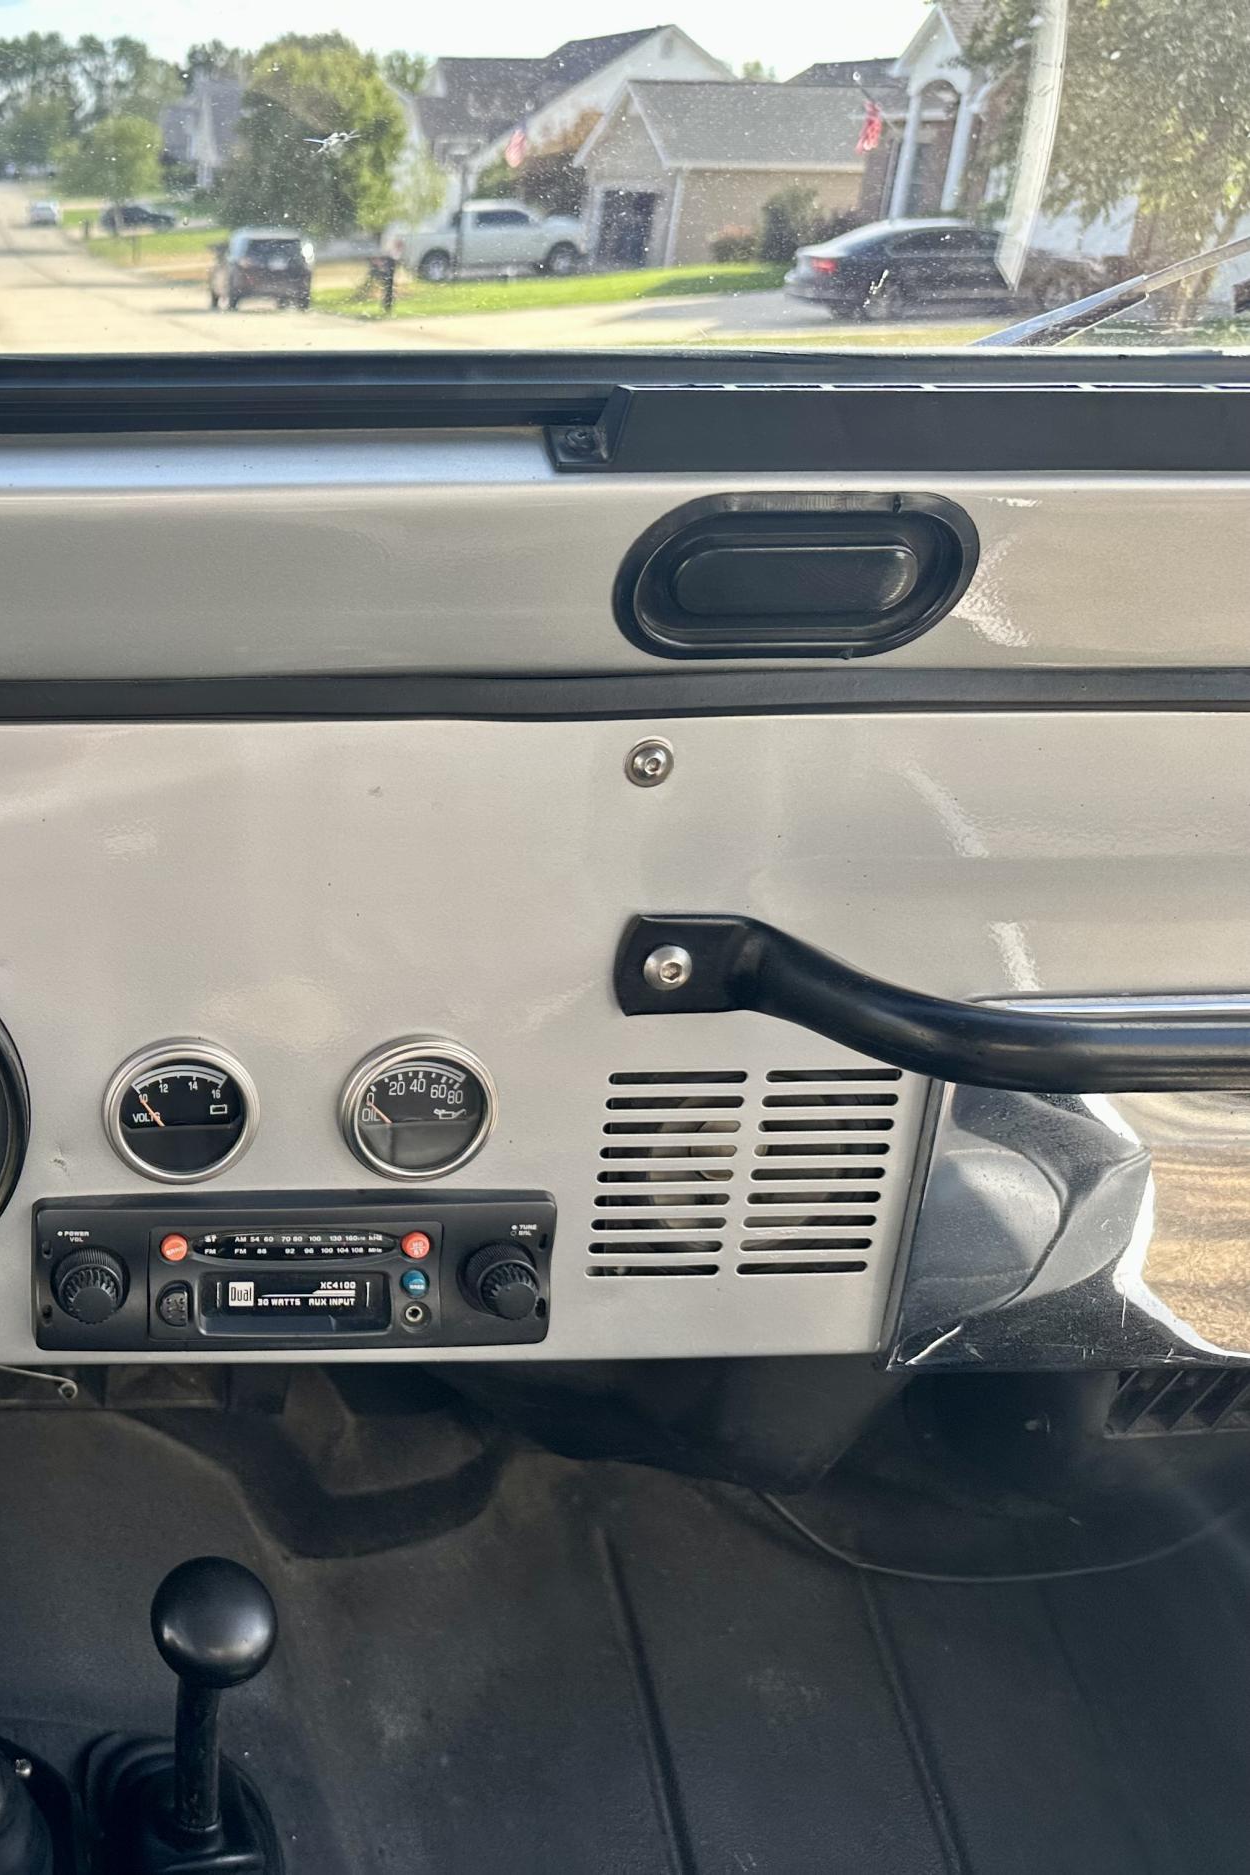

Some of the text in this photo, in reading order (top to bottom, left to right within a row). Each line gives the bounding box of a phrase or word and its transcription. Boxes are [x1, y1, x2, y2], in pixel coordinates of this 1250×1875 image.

[158, 1083, 169, 1093] 12
[188, 1081, 198, 1091] 14
[388, 1081, 406, 1096] 20
[409, 1078, 426, 1093] 40
[430, 1084, 447, 1099] 60
[211, 1089, 221, 1099] 16
[447, 1090, 463, 1105] 80
[361, 1107, 381, 1122] OIL
[320, 1281, 356, 1290] XC4100
[230, 1286, 252, 1302] Dual
[257, 1298, 356, 1306] 30 WATTS AUX INPUT
